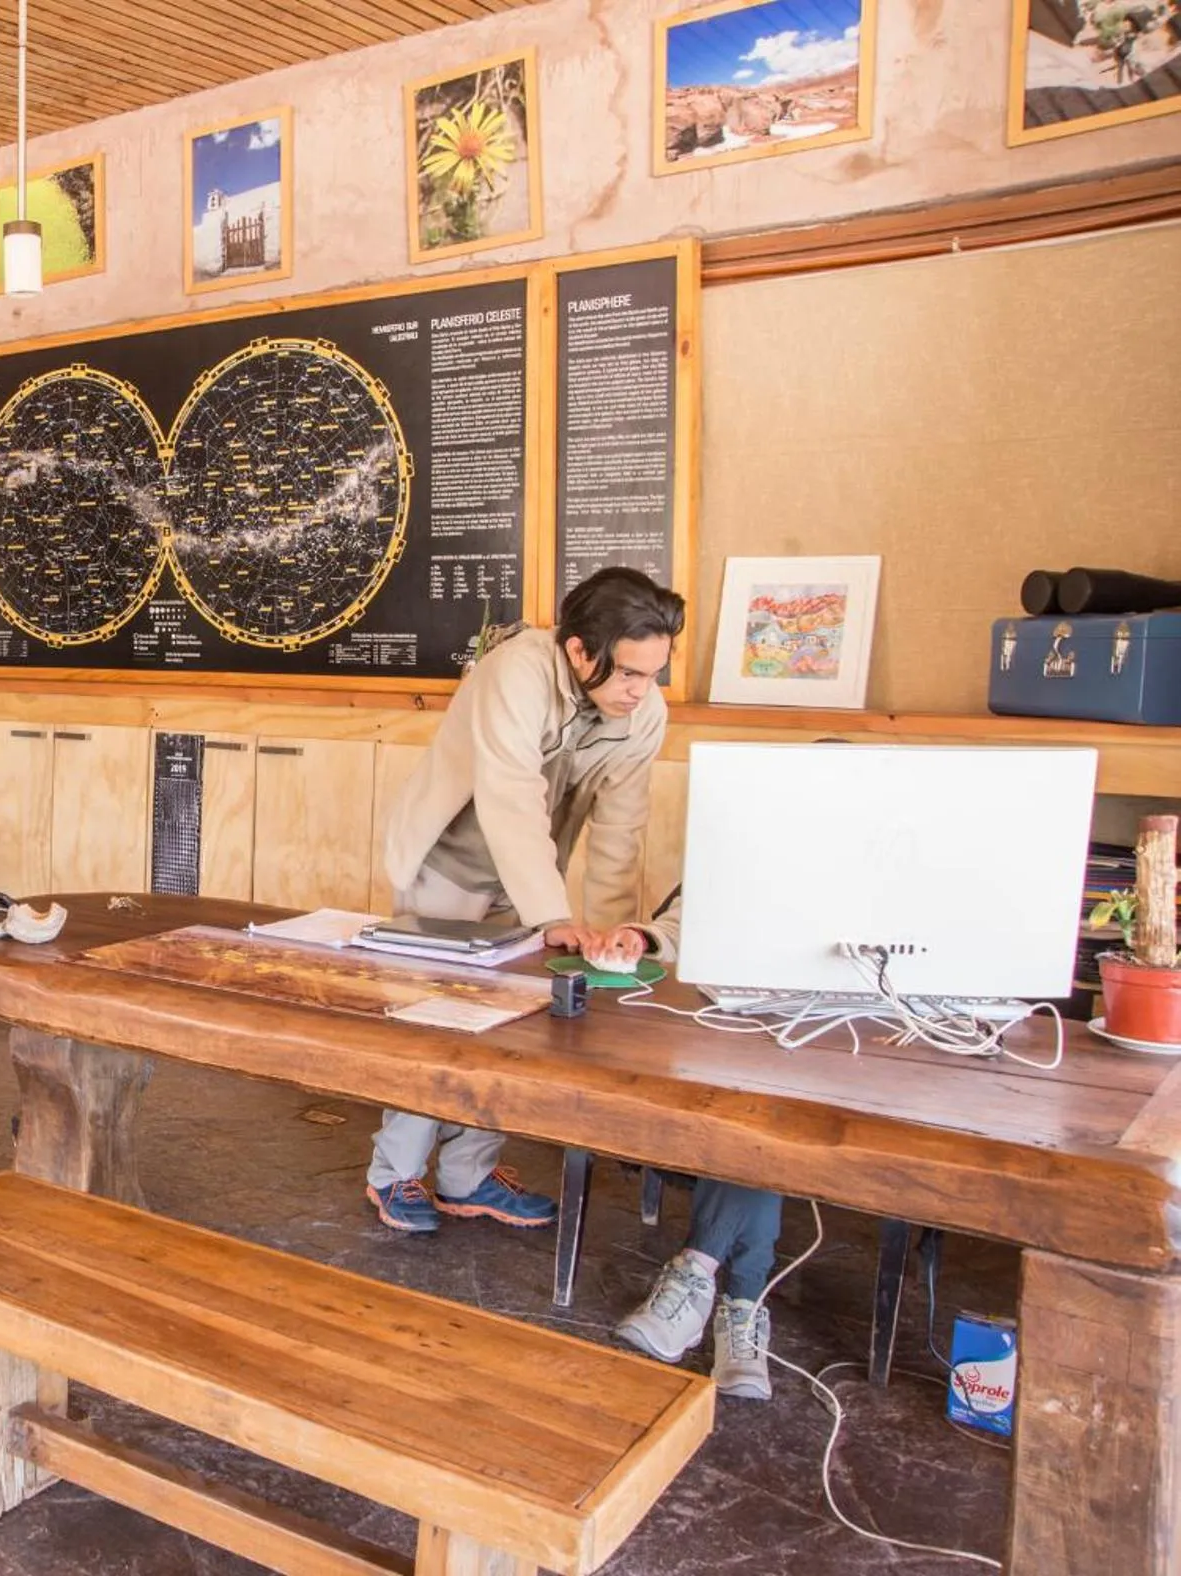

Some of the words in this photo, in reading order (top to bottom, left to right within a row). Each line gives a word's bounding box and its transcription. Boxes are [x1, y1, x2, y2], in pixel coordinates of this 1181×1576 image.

[568, 294, 632, 313] PLANISPHERE
[431, 312, 484, 330] PLANISFERIO
[486, 307, 521, 323] CELESTE
